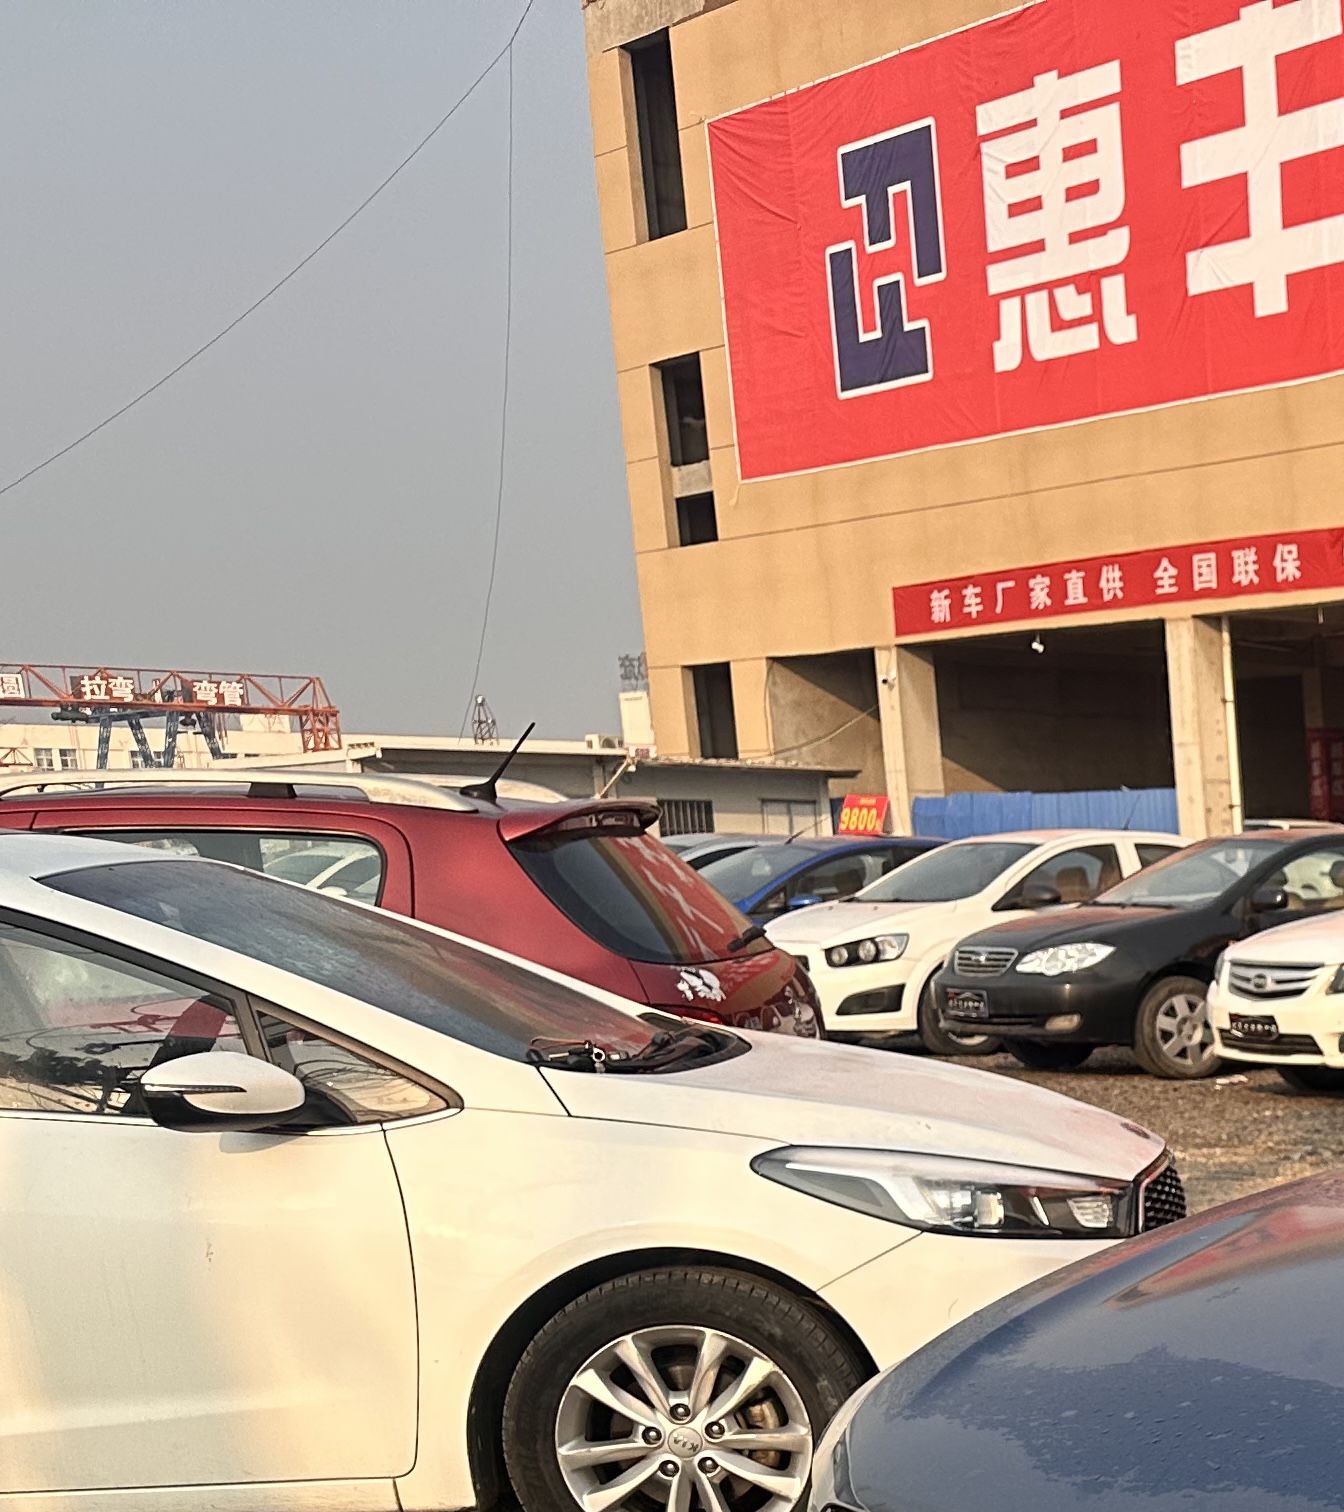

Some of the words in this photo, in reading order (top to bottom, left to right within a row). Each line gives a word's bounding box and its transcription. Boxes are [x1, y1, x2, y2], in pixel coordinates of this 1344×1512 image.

[929, 560, 1125, 624] 新车厂家直供
[1153, 541, 1303, 595] 全国联保
[81, 676, 135, 703] 拉弯
[193, 680, 244, 707] 弯管
